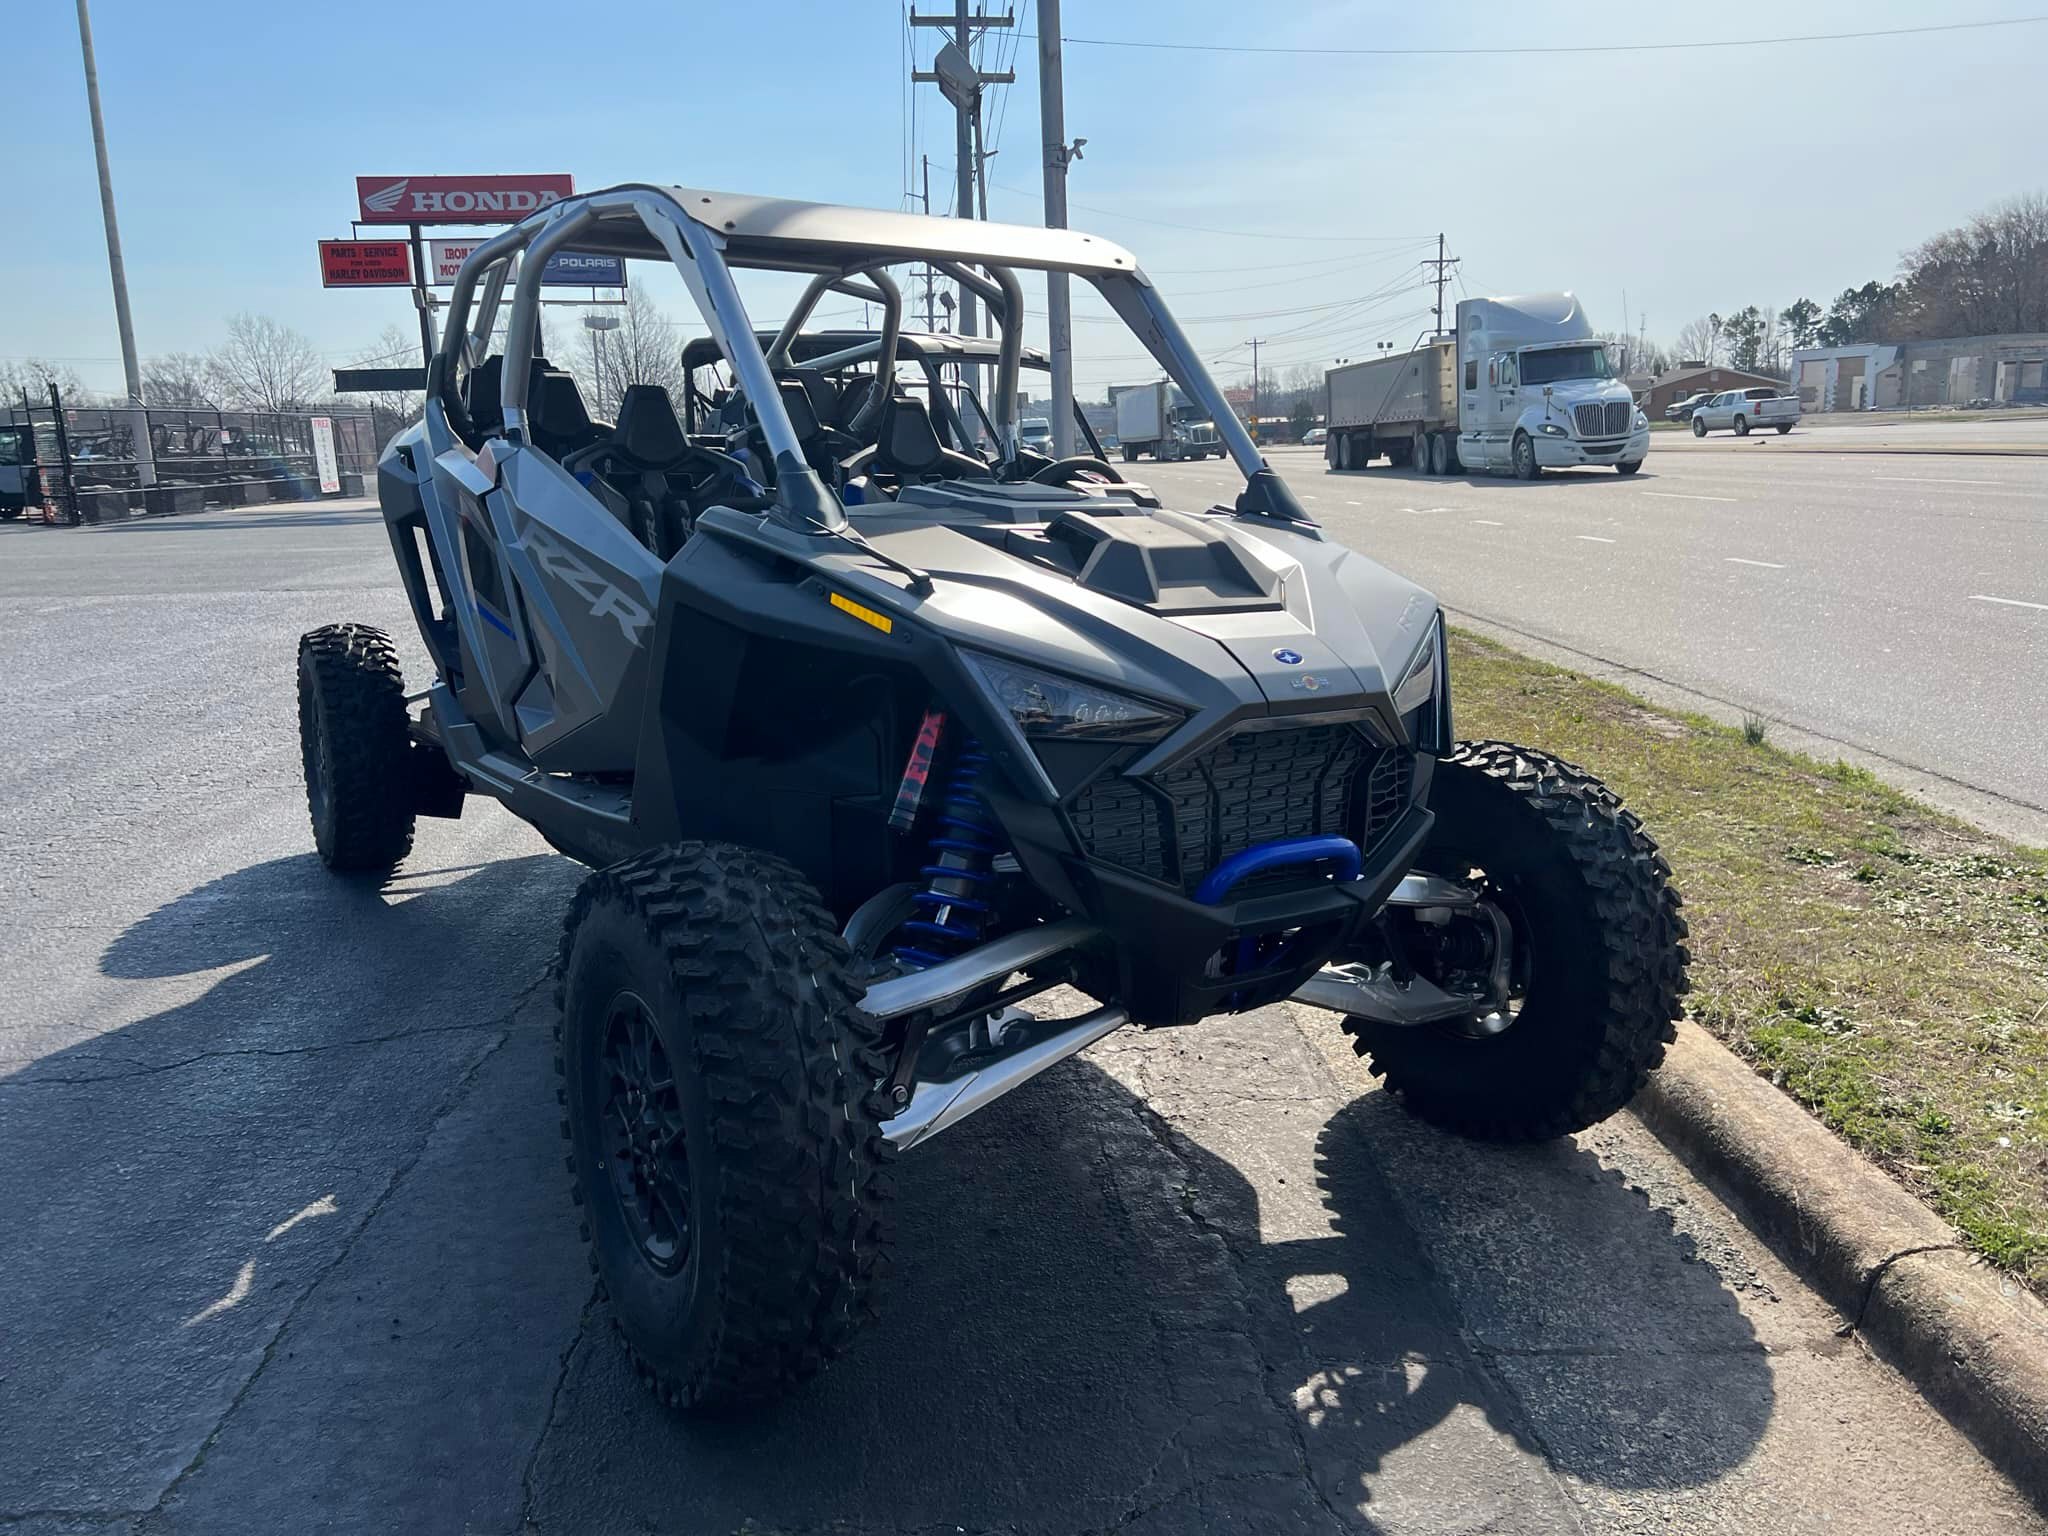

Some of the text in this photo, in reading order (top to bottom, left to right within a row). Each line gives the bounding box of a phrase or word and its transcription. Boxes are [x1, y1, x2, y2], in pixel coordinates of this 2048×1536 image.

[411, 190, 562, 212] HONDA
[330, 247, 398, 258] PARTS SERVICE
[444, 248, 468, 259] IRON
[559, 258, 617, 268] POLARIS
[330, 268, 404, 279] HARLEY DAVIDSON
[509, 520, 656, 649] RZR
